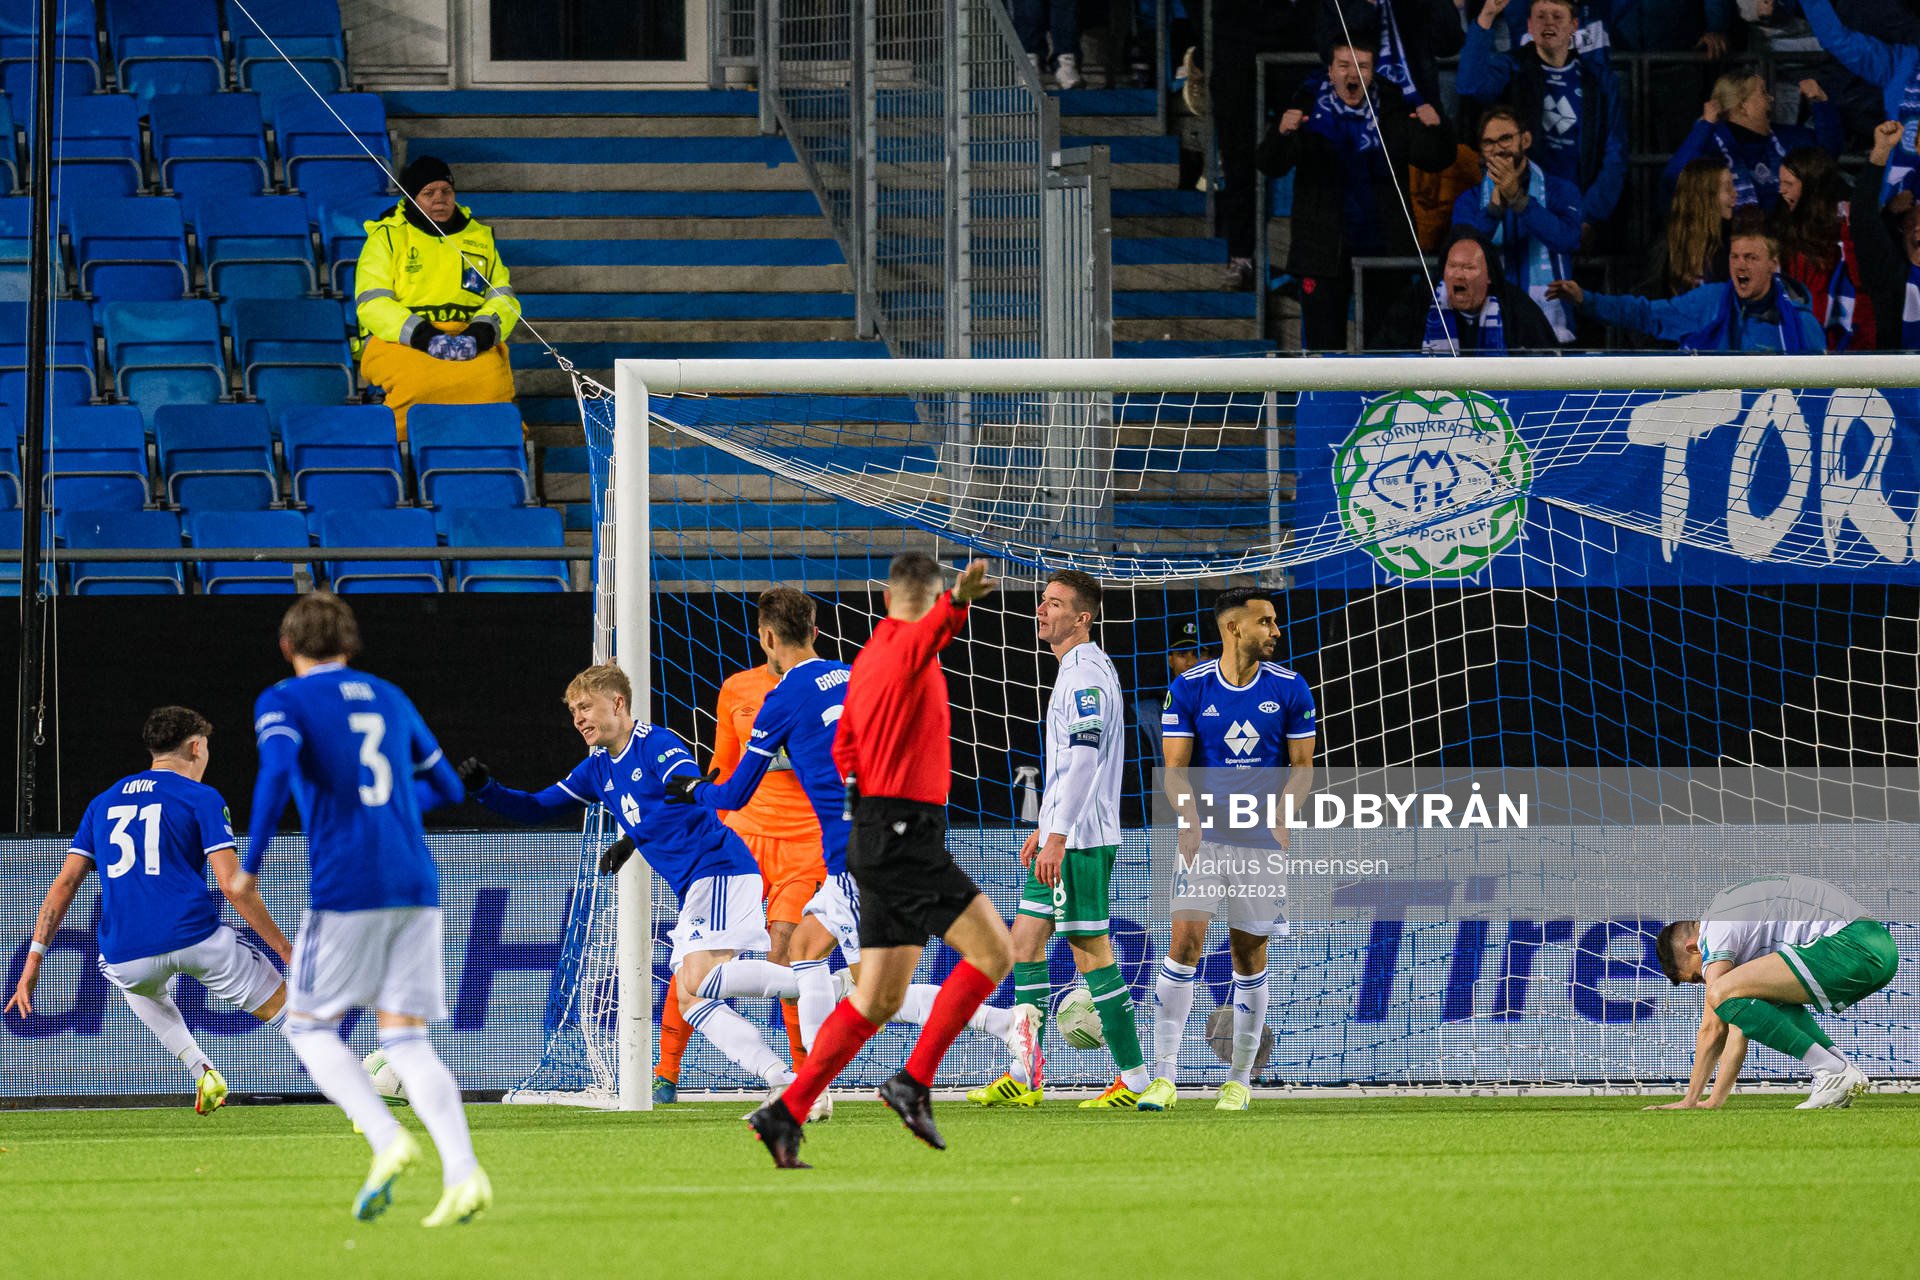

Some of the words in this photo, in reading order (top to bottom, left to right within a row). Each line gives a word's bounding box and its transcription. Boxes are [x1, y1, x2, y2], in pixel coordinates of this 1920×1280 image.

[1081, 695, 1096, 707] SQ
[122, 780, 157, 794] LØVIK
[348, 713, 393, 807] 3
[107, 804, 162, 878] 31
[1331, 876, 1667, 1023] Tire
